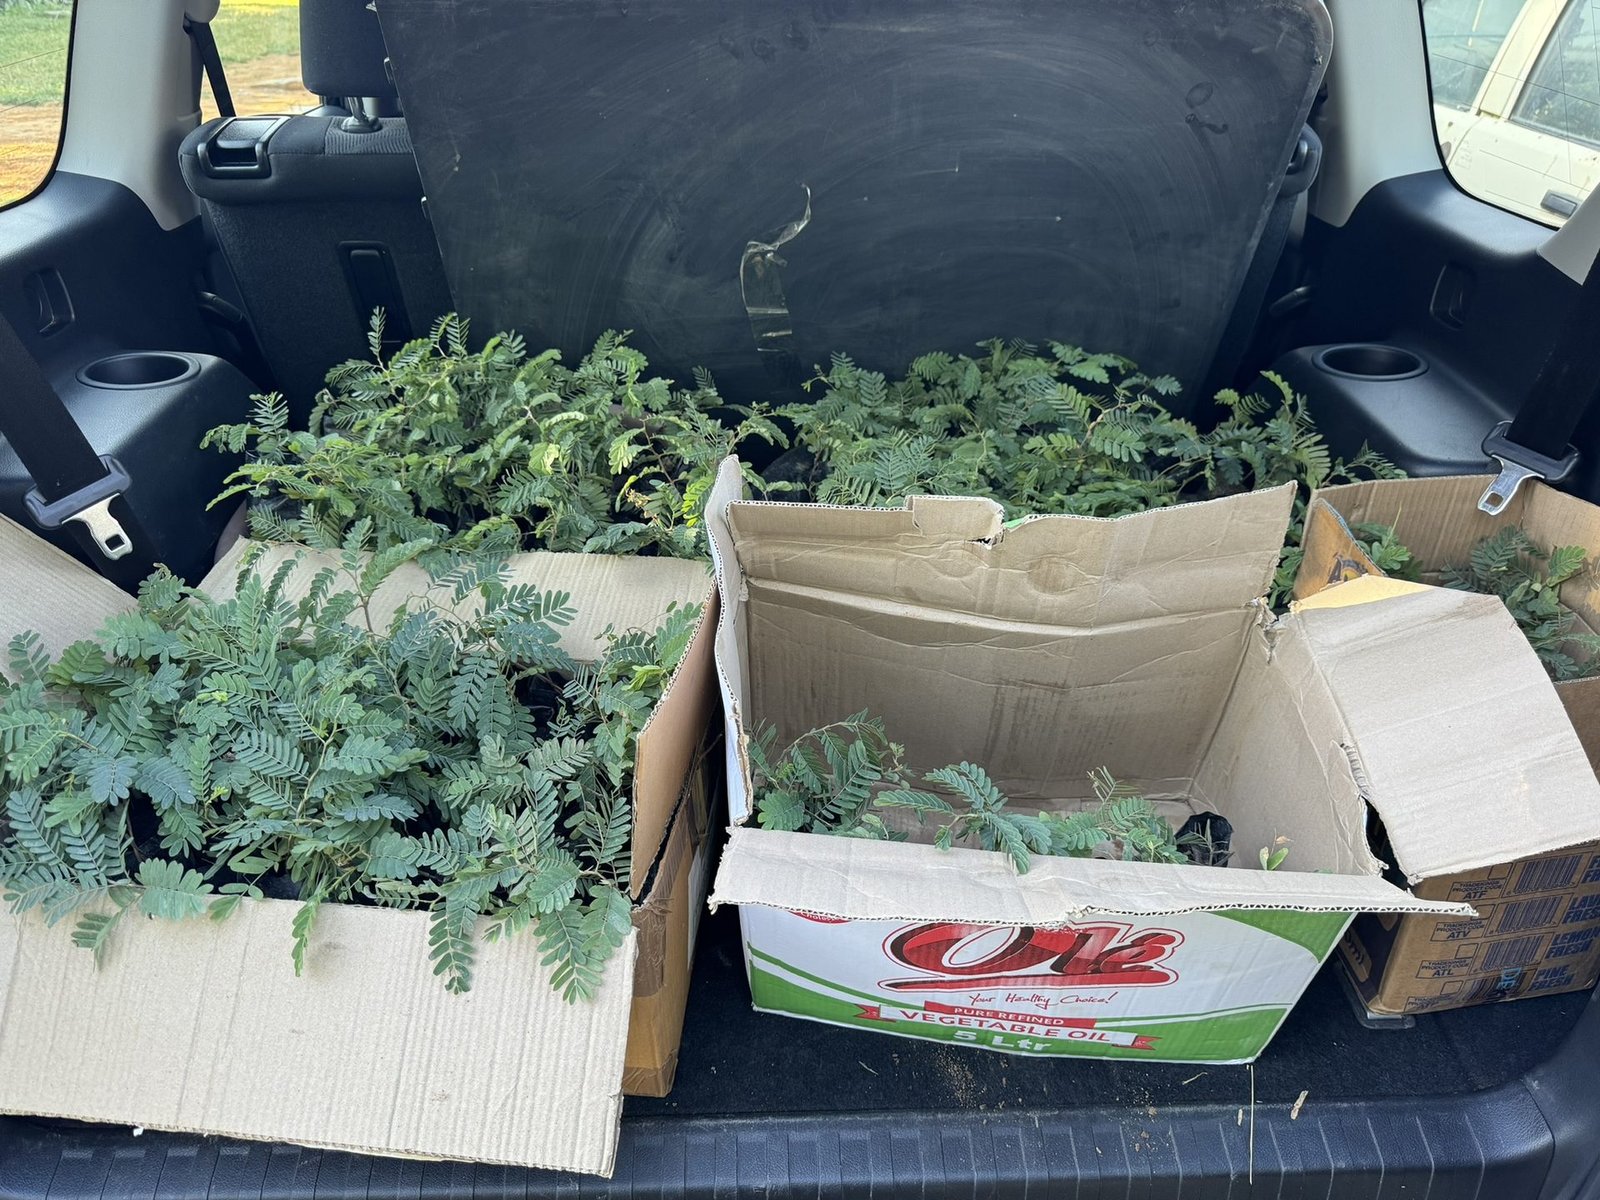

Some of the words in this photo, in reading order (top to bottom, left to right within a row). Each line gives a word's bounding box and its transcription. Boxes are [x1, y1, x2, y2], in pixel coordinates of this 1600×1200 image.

[1463, 891, 1487, 900] ATF
[1447, 930, 1471, 939] ATV
[1432, 969, 1454, 977] ATL
[969, 994, 996, 1005] Your
[1005, 993, 1054, 1010] Healthy
[1059, 992, 1119, 1005] Choice!
[954, 1007, 994, 1018] PURE
[998, 1011, 1064, 1026] REFINED
[899, 1010, 1059, 1037] VEGETABLE
[1068, 1030, 1112, 1042] OIL
[953, 1030, 977, 1041] 5
[991, 1036, 1053, 1052] Ltr
